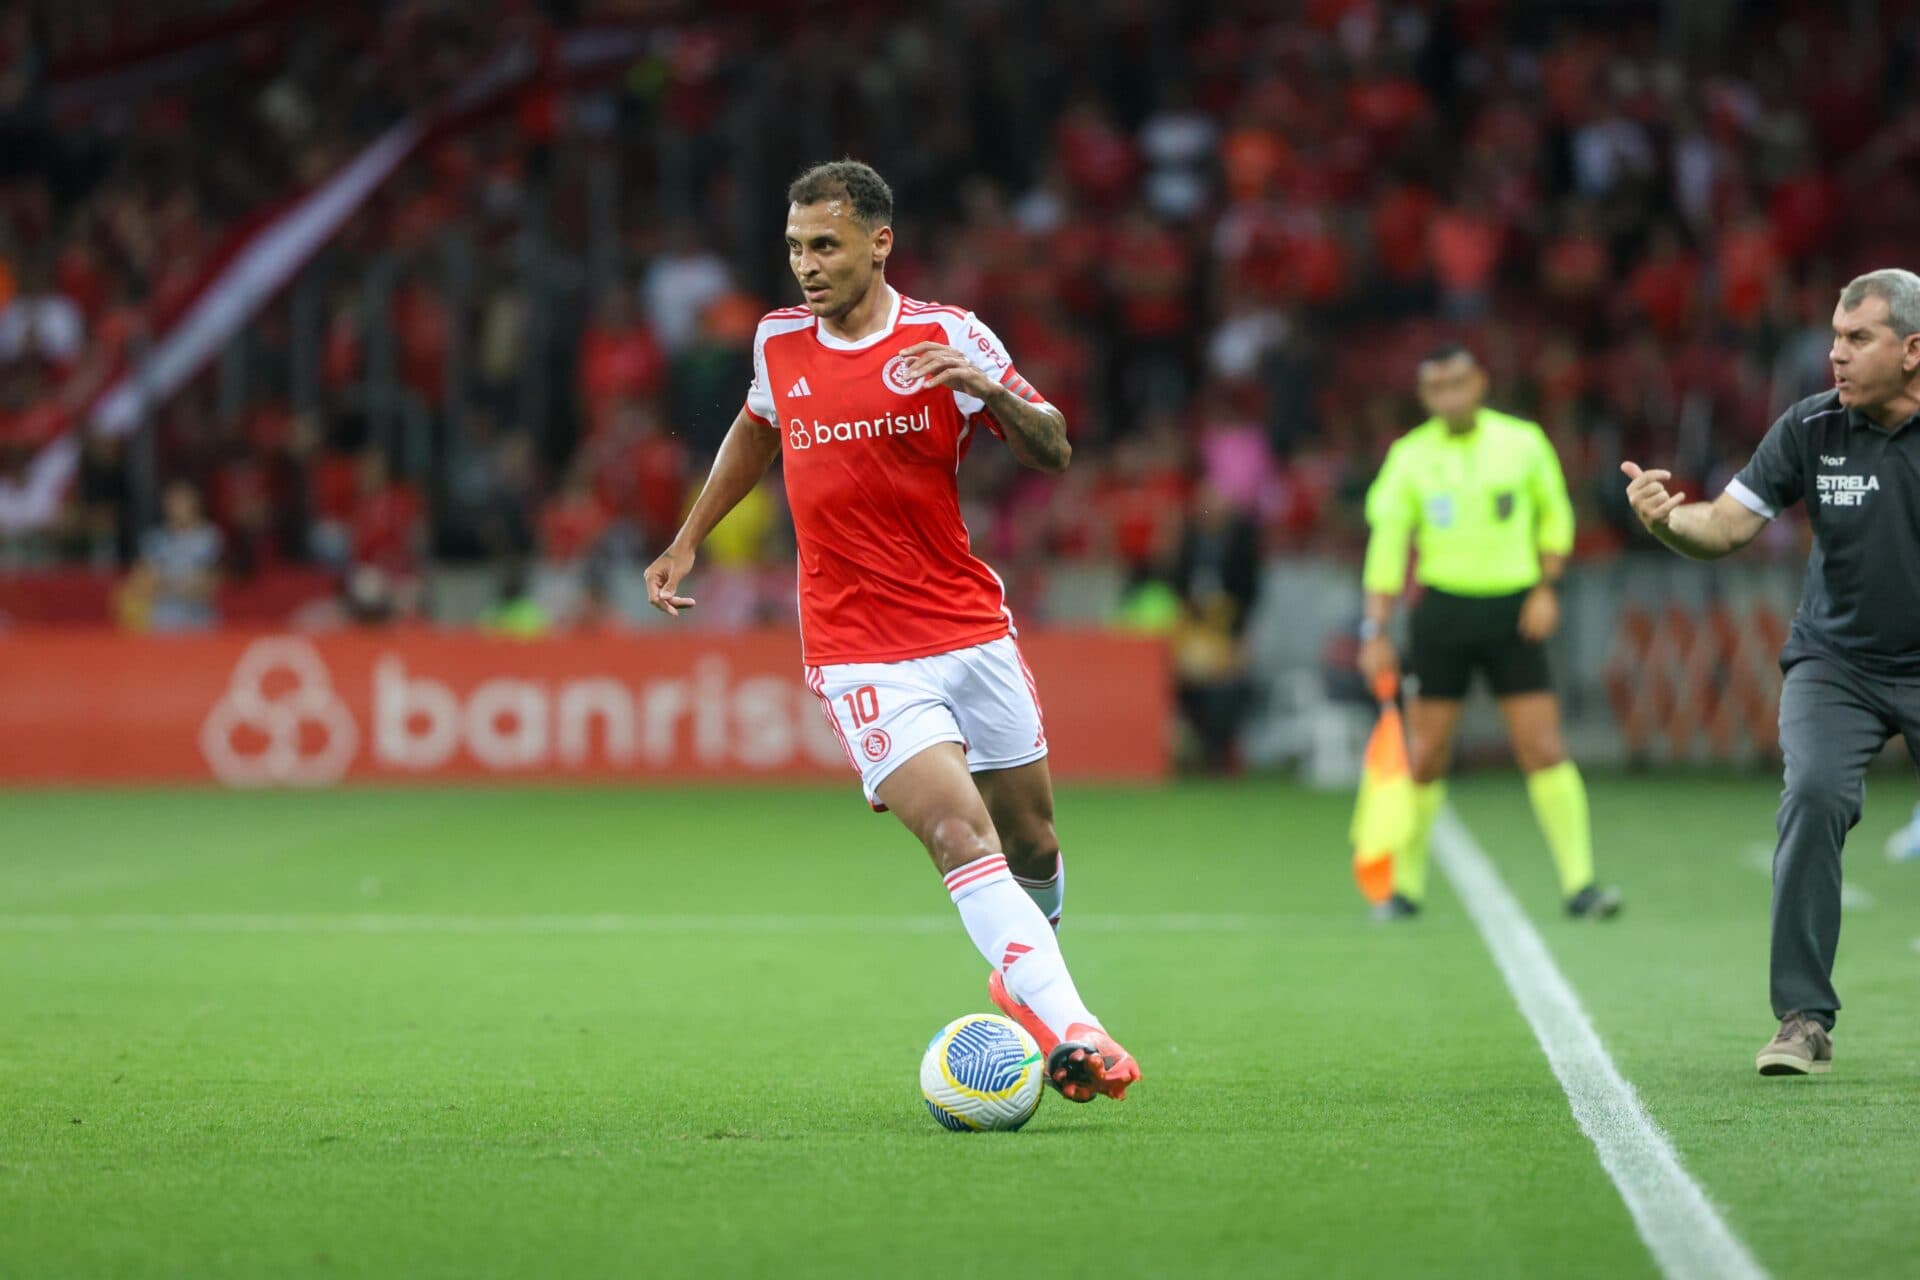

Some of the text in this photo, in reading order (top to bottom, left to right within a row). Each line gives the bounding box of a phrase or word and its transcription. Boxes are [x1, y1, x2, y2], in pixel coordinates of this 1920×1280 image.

[814, 405, 931, 444] banrisul
[1834, 491, 1866, 506] BET
[843, 685, 880, 729] 10
